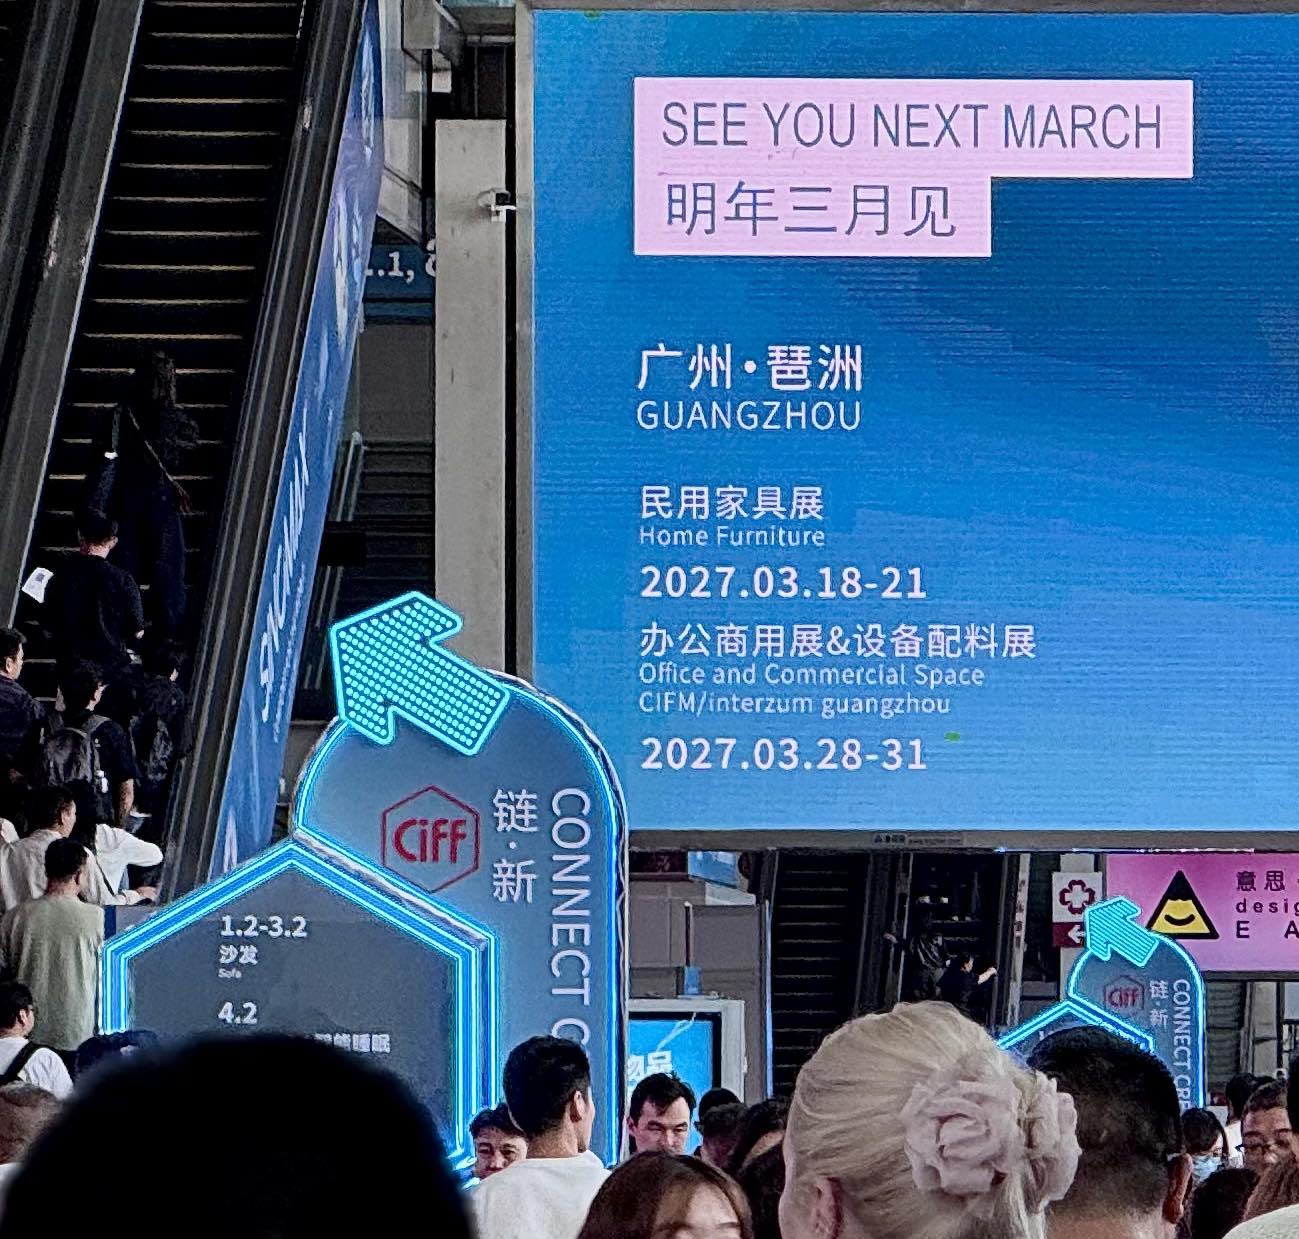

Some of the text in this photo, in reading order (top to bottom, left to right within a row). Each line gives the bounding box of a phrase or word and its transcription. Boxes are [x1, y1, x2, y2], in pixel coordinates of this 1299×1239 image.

[662, 102, 1162, 149] SEE YOU NEXT MARCH
[665, 179, 958, 238] 明年三月见
[636, 343, 864, 392] 广州·琶洲
[636, 400, 863, 431] GUANGZHOU
[640, 485, 825, 522] 民用家具展
[639, 526, 826, 548] Home Furniture
[640, 566, 927, 600] 2027.03.18-21
[640, 622, 1037, 660] 办公商用展&设备配料展
[639, 662, 986, 690] Office and Commercial Space
[639, 690, 952, 720] CIFM/interzum guangzhou
[640, 737, 927, 771] 2027.03.28-31
[550, 788, 592, 1007] CONNECT
[219, 914, 308, 938] 1.2-3.2
[218, 944, 259, 966] 沙发
[217, 1001, 258, 1025] 4.2
[1173, 978, 1192, 1071] CONNECT
